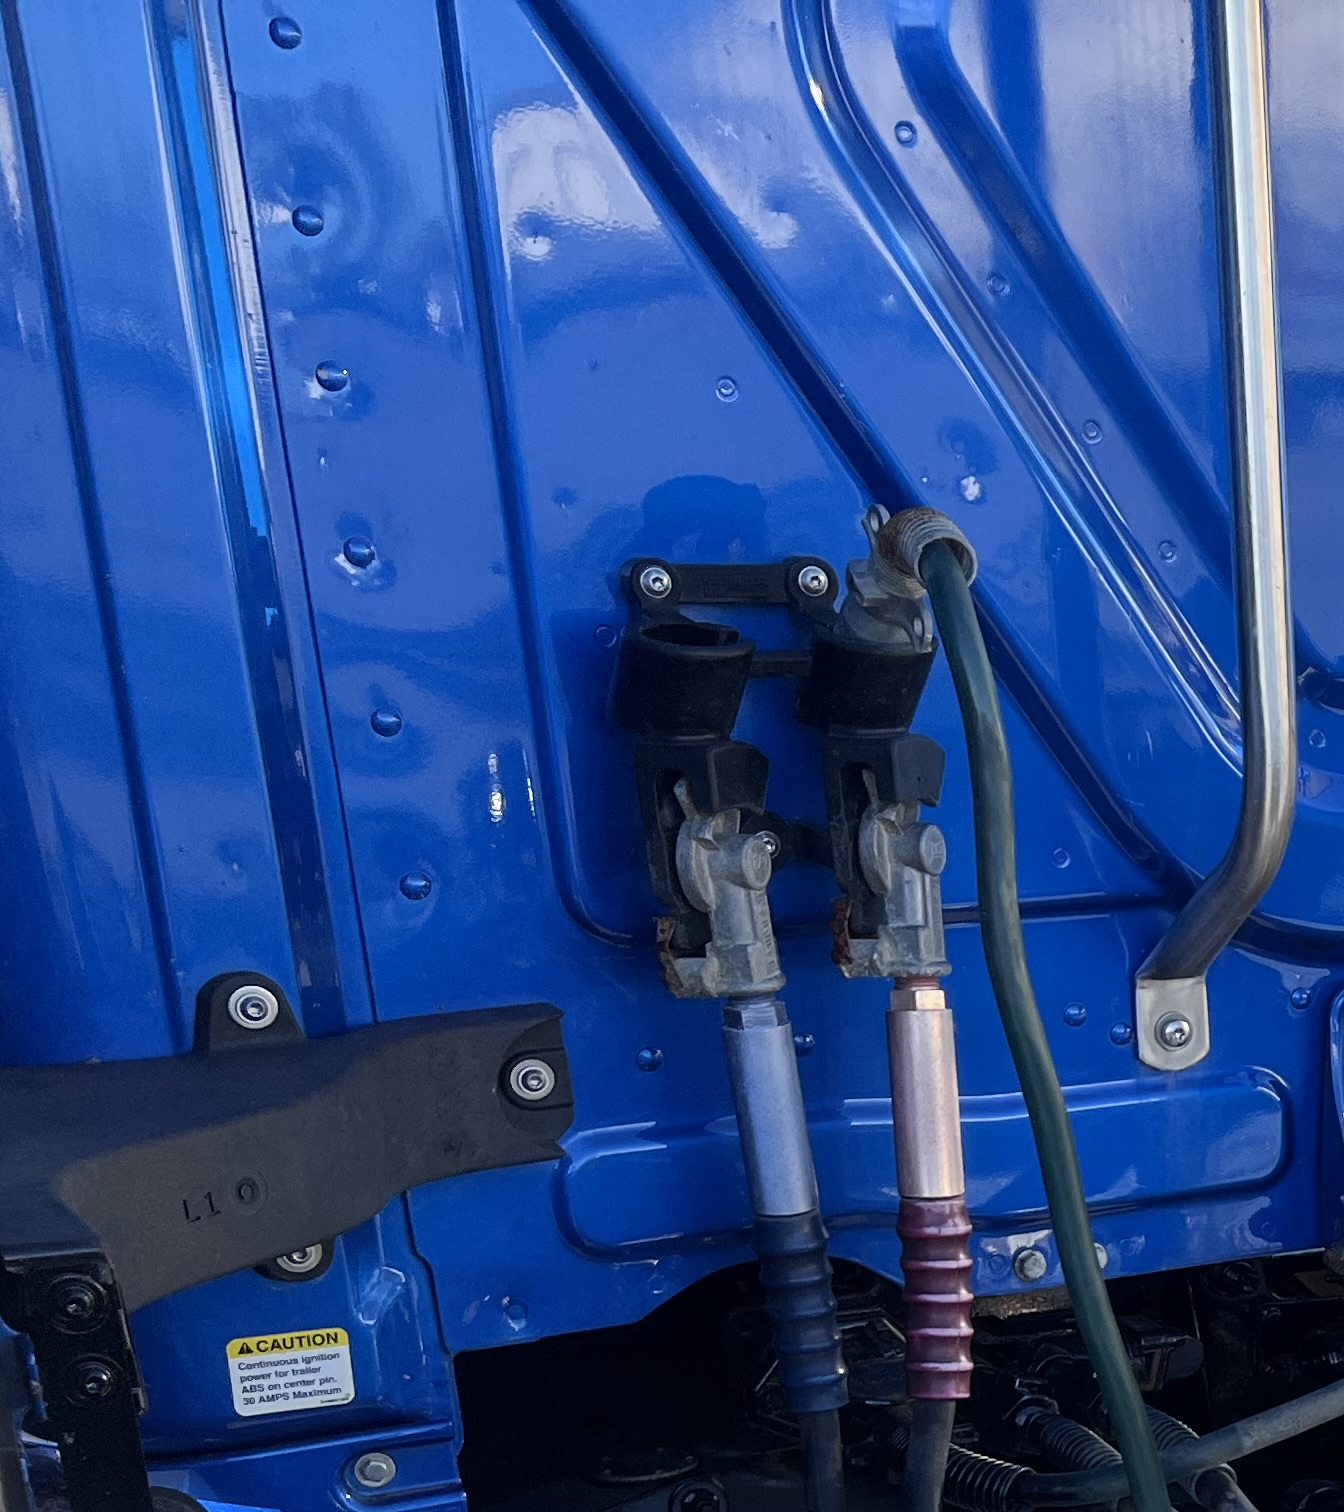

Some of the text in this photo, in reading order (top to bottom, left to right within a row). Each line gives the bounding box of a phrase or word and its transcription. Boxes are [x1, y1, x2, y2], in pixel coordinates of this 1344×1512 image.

[256, 1331, 339, 1354] CAUTION
[237, 1358, 300, 1371] Continuous
[239, 1366, 322, 1385] power for trailer
[241, 1376, 338, 1394] ABS on center pin.
[243, 1395, 256, 1406] 30
[257, 1392, 290, 1404] AMPS
[292, 1386, 343, 1400] Maximum
